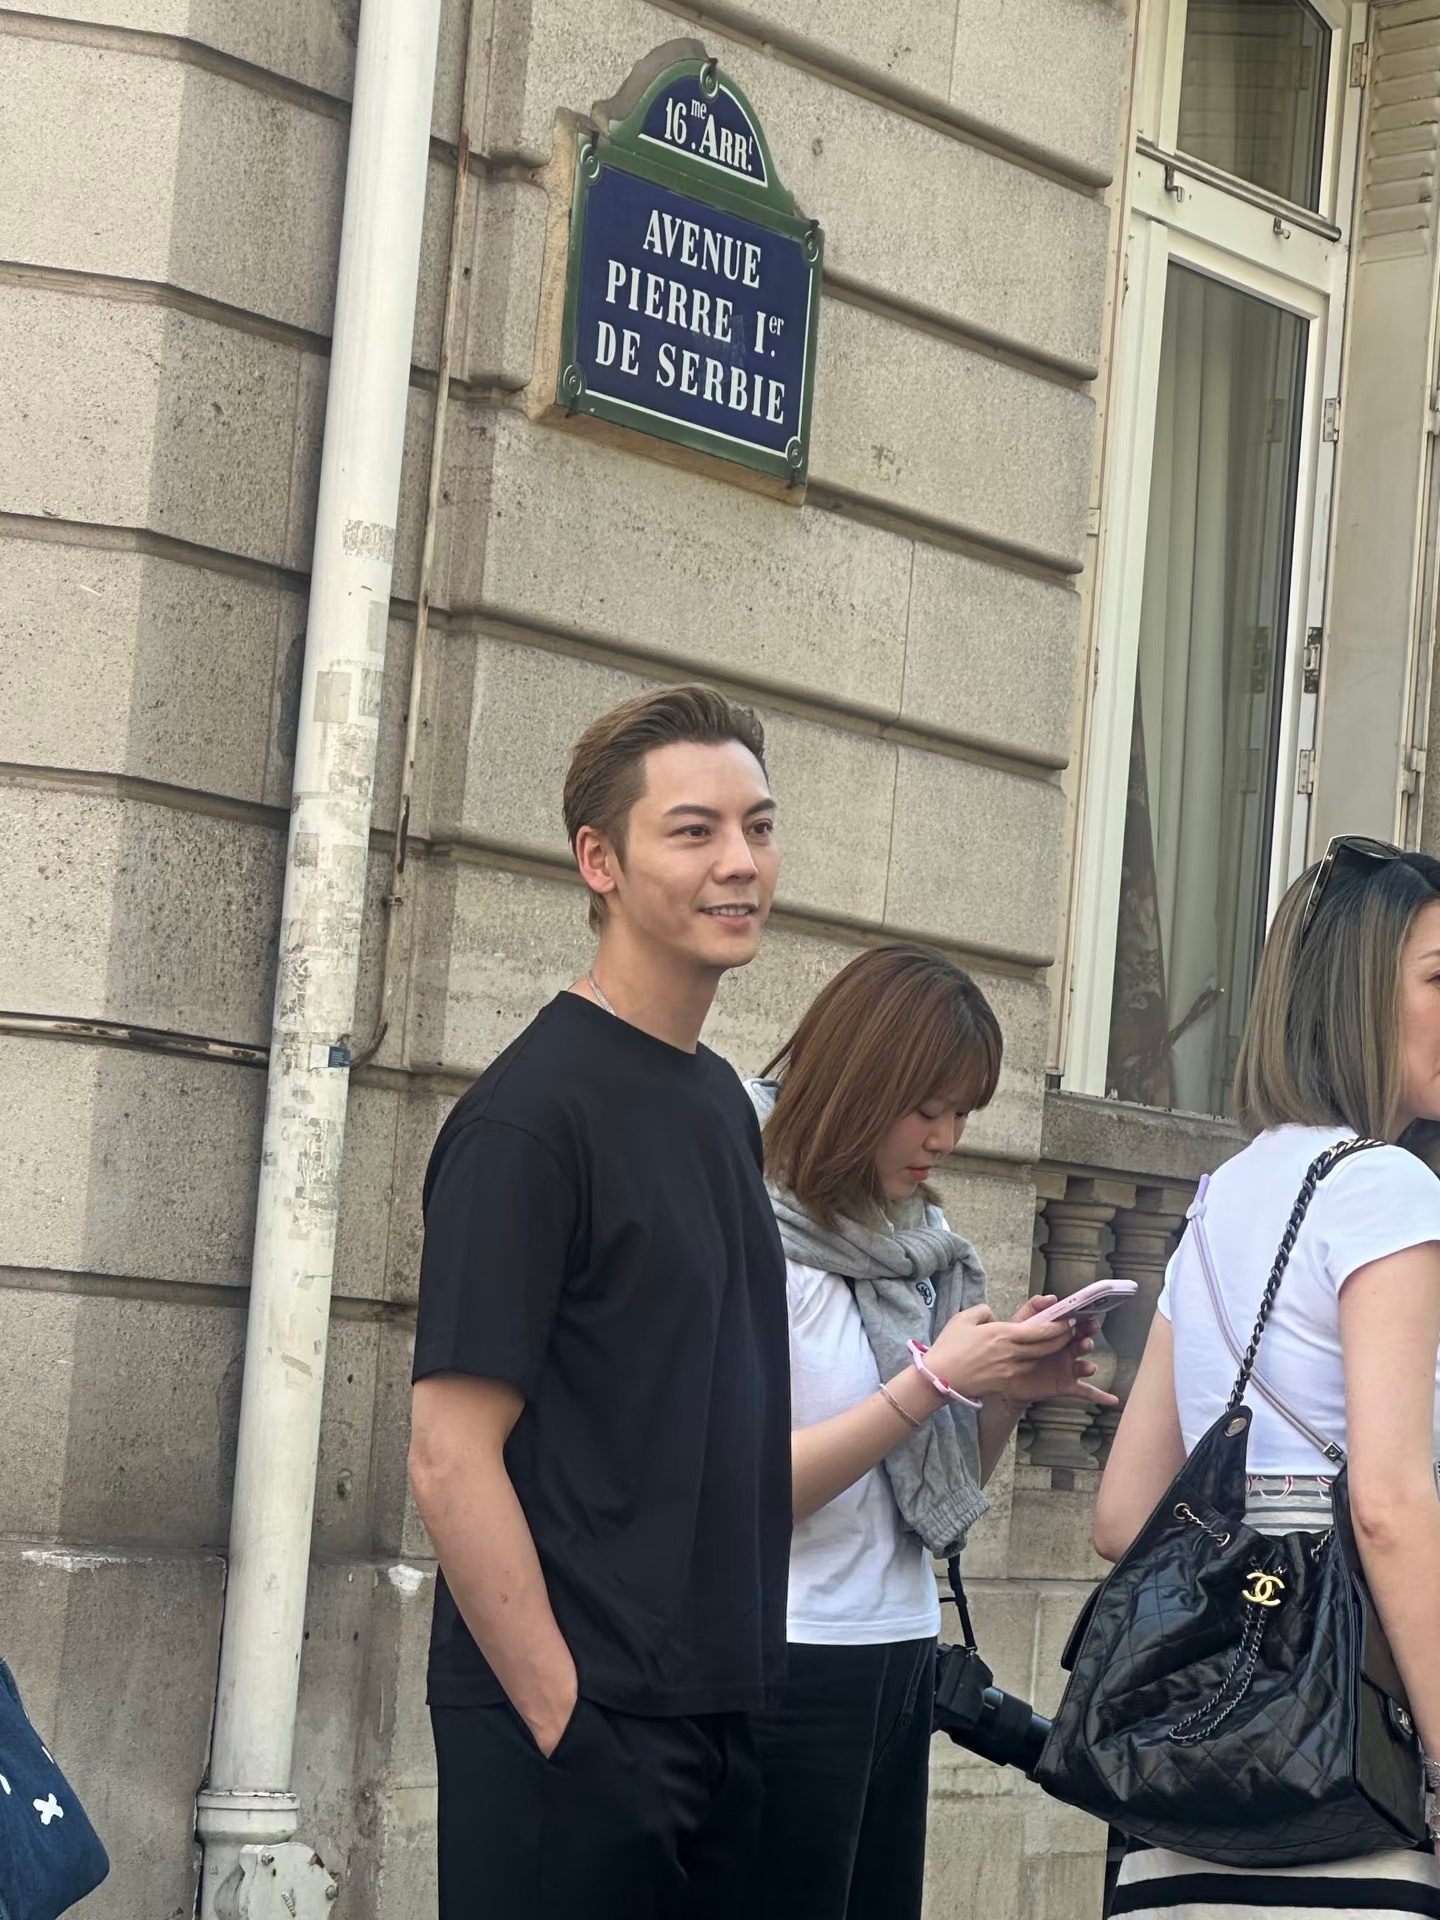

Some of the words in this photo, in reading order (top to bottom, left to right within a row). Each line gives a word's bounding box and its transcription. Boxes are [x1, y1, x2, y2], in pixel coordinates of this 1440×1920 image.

[643, 209, 761, 289] AVENUE
[605, 259, 733, 343] PIERRE
[595, 320, 641, 376] DE
[656, 342, 785, 425] SERBIE
